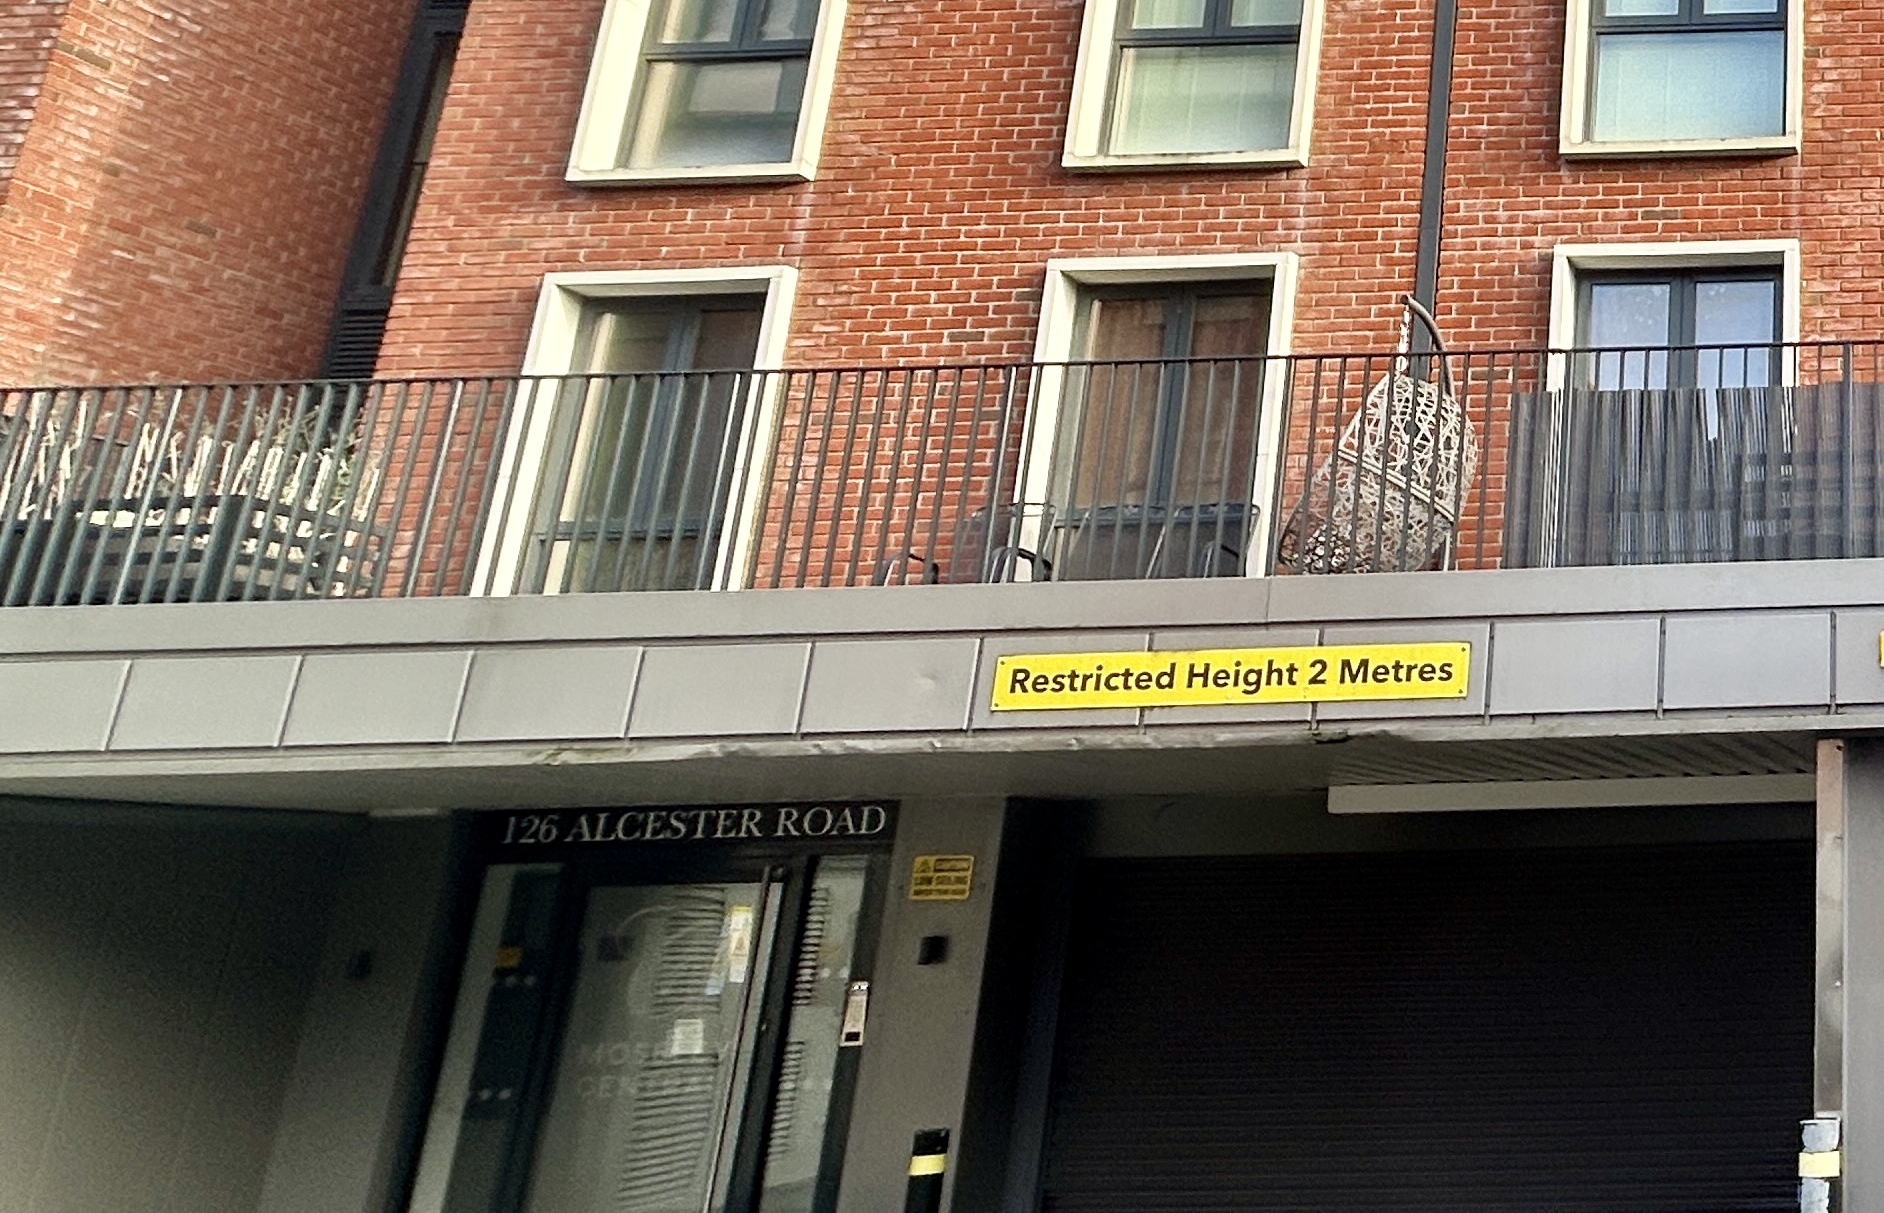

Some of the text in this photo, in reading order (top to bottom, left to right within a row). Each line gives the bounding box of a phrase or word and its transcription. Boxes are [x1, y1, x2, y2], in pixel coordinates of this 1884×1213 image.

[1009, 658, 1454, 695] Restricted Height 2 Metres
[501, 805, 887, 844] 126 ALCESTER ROAD
